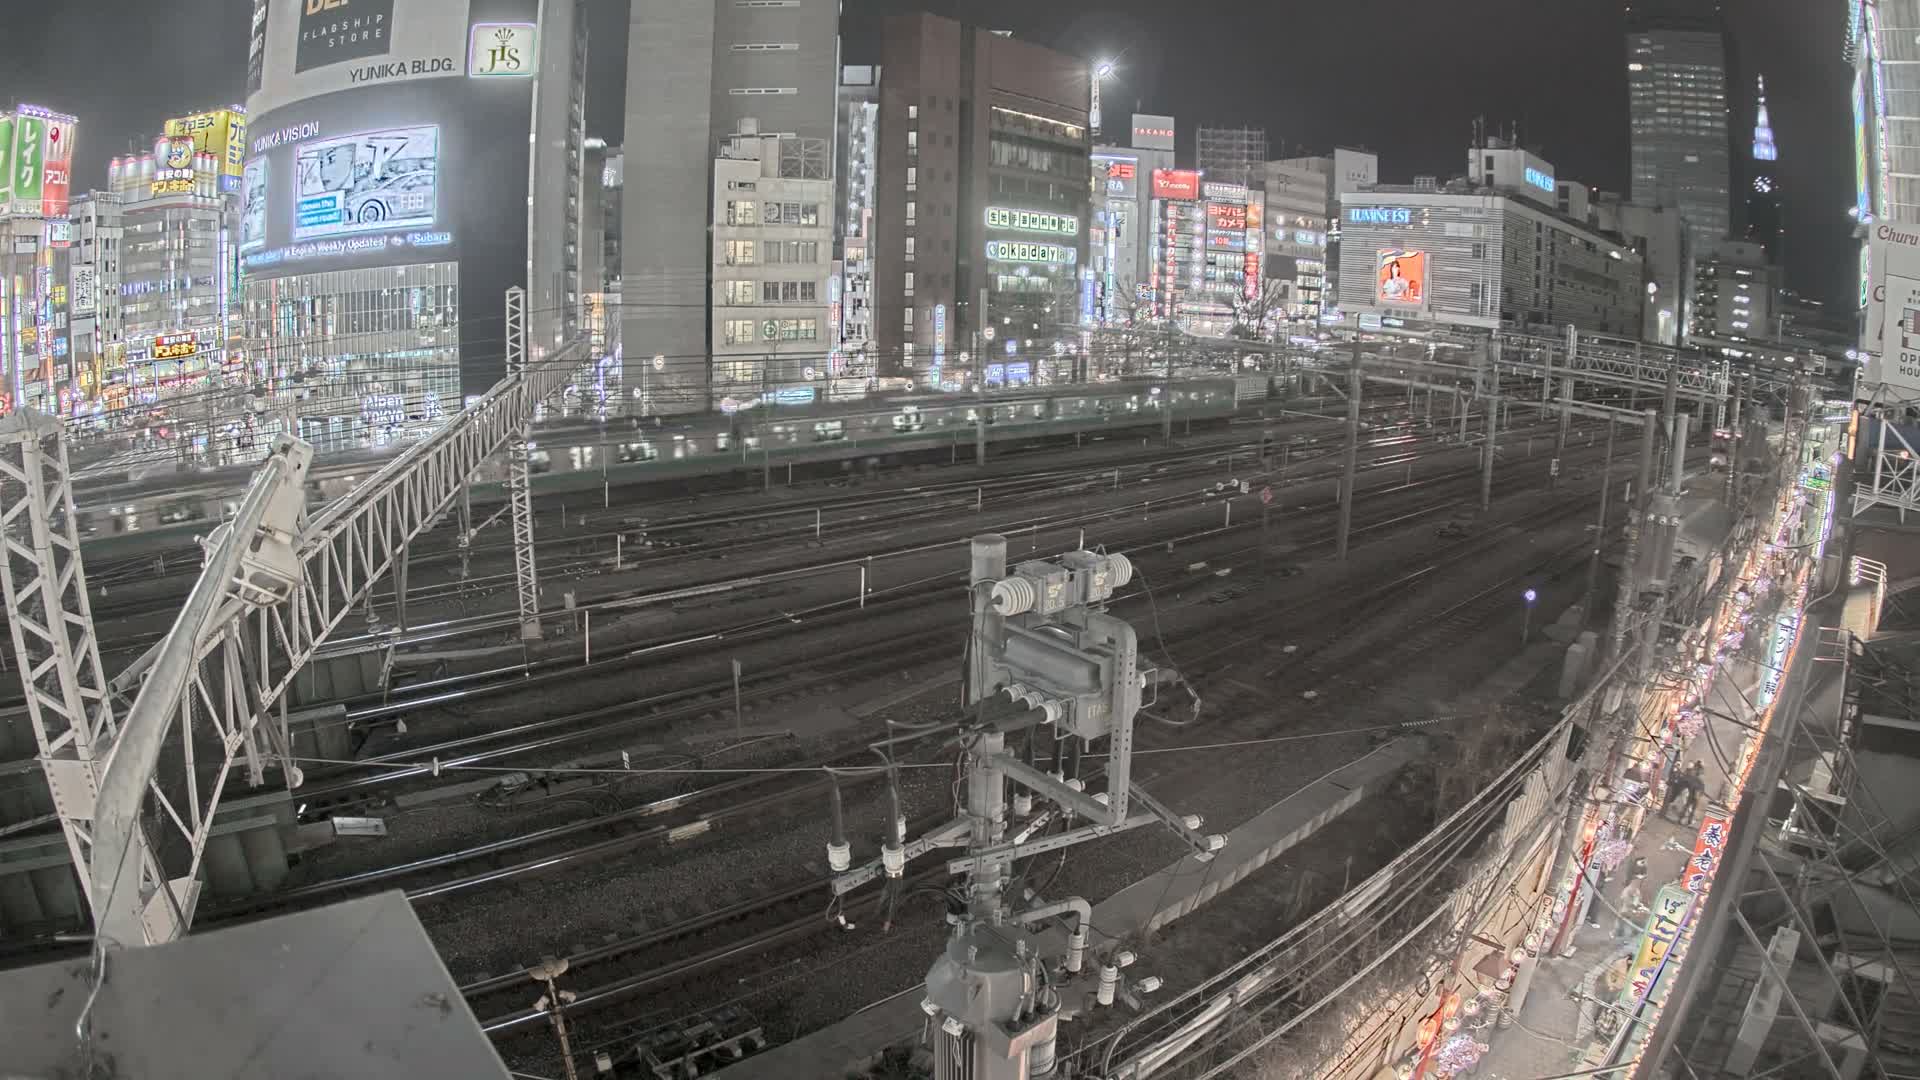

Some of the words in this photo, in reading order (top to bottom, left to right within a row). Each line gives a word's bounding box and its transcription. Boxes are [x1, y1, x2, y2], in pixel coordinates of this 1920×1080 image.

[303, 14, 384, 41] FLAGSHIP
[328, 28, 382, 48] STORE
[350, 62, 407, 83] YUNIKA
[412, 58, 456, 73] BLDG.
[254, 131, 282, 153] YUNIKA
[283, 120, 320, 143] VISION
[1134, 127, 1175, 137] TAKANO
[20, 120, 37, 189] レイク
[45, 169, 68, 185] アコム
[1351, 208, 1391, 222] LUMINE
[1392, 208, 1411, 224] EST
[1877, 225, 1919, 246] Churu
[999, 244, 1065, 262] okadaya
